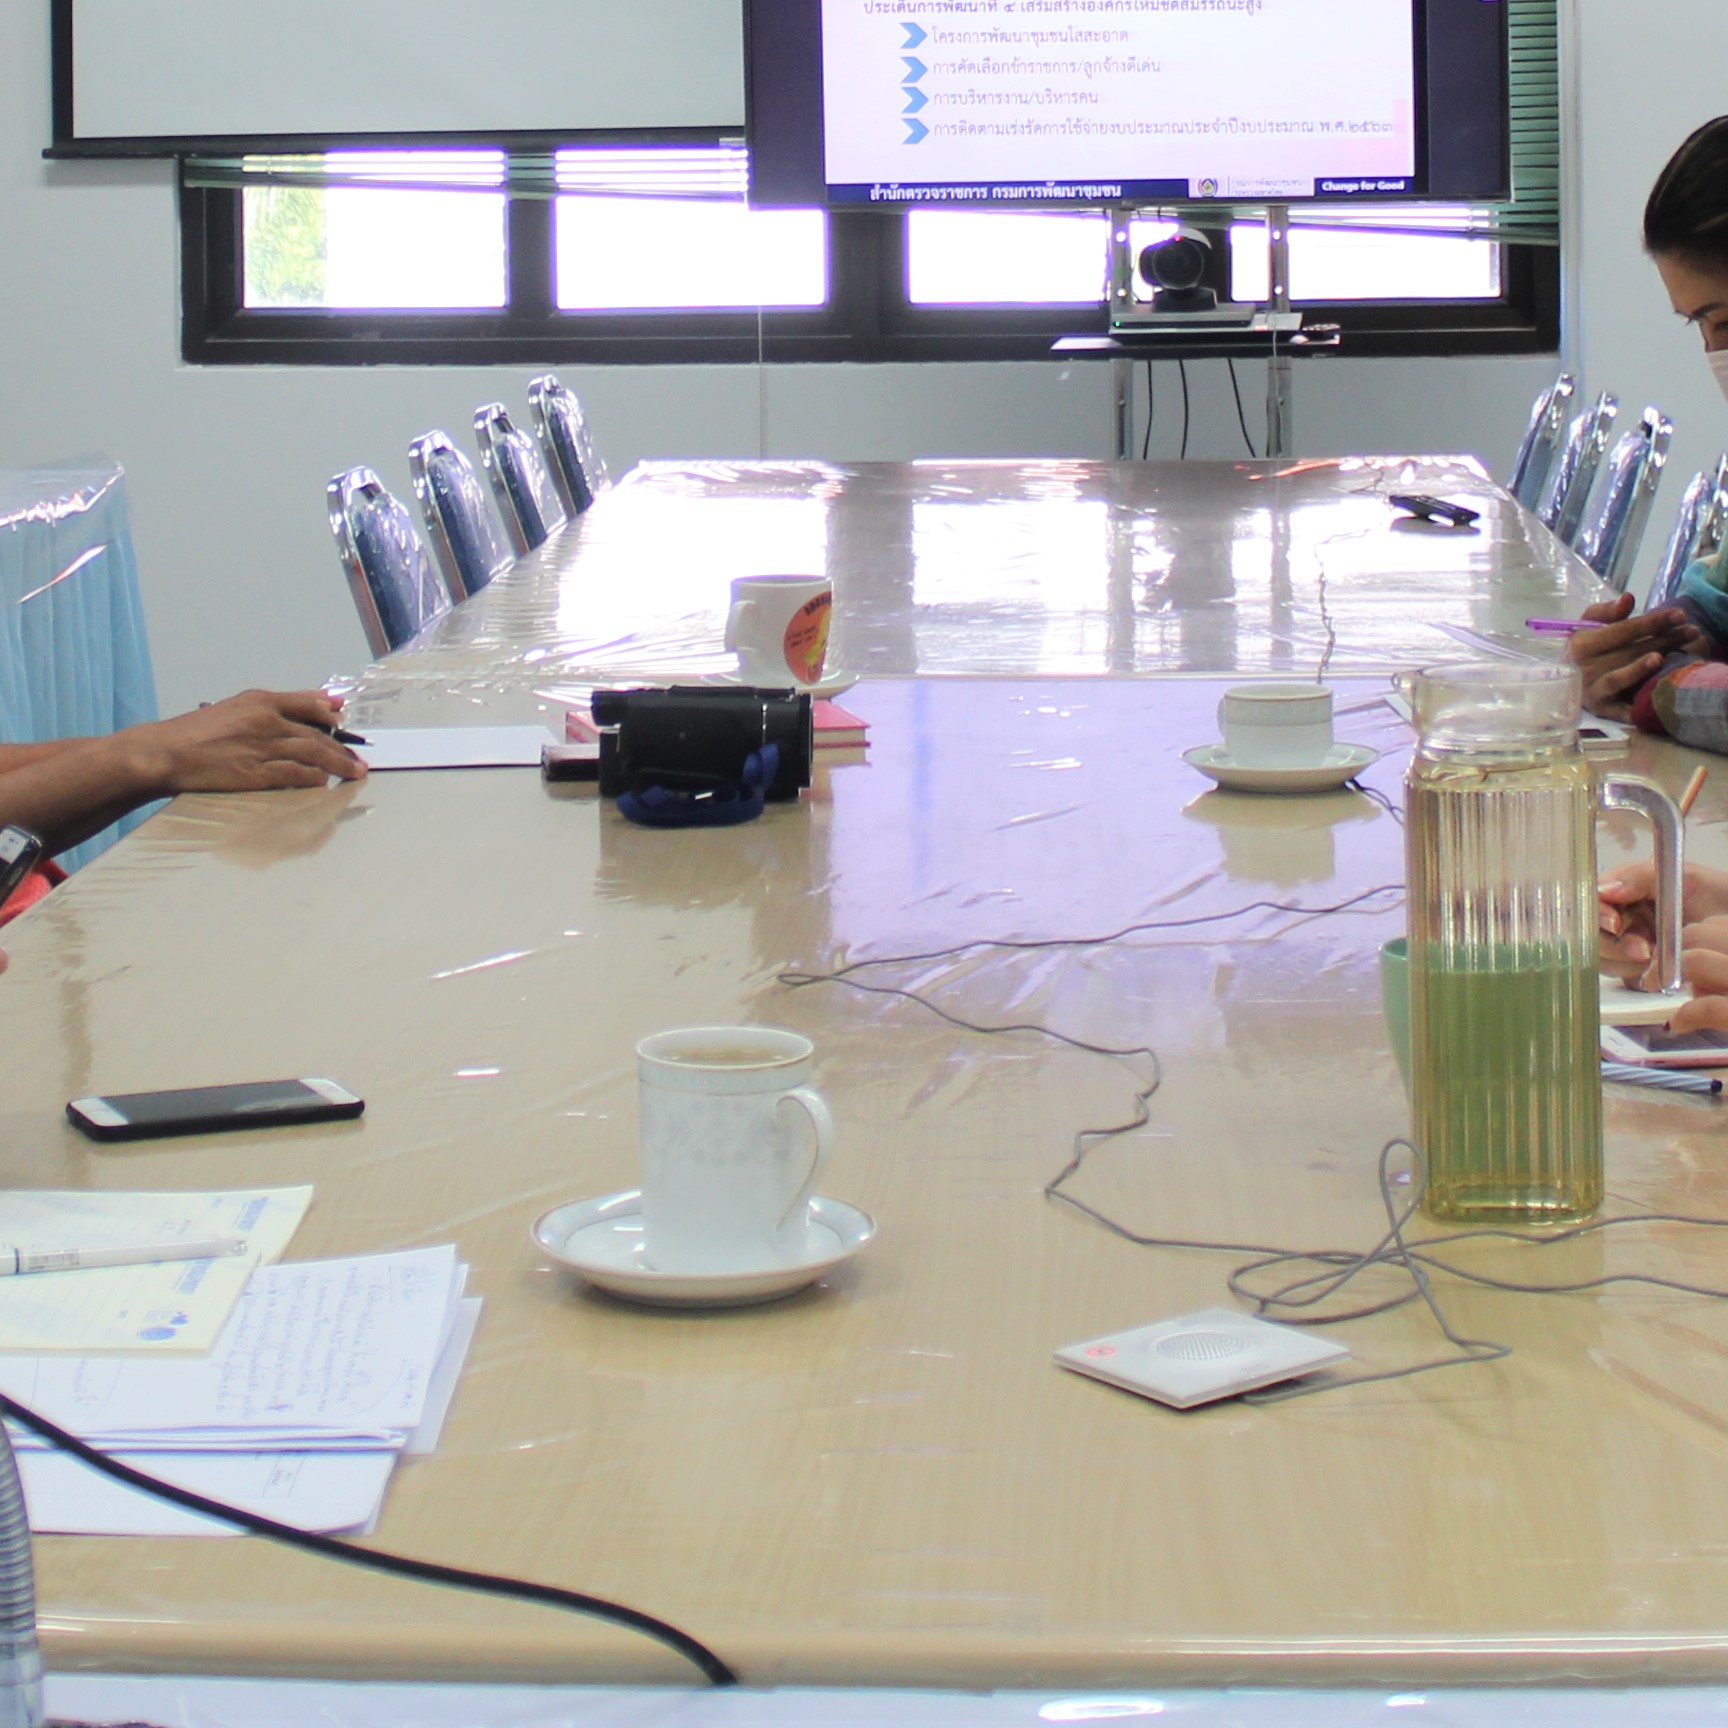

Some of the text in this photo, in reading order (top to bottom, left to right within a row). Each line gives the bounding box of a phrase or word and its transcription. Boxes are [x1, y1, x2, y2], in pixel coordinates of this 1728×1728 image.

[869, 181, 1122, 201] สำนักตรวจราชการ กรมการพัฒนาชุมชน
[1321, 180, 1405, 193] Change for Good
